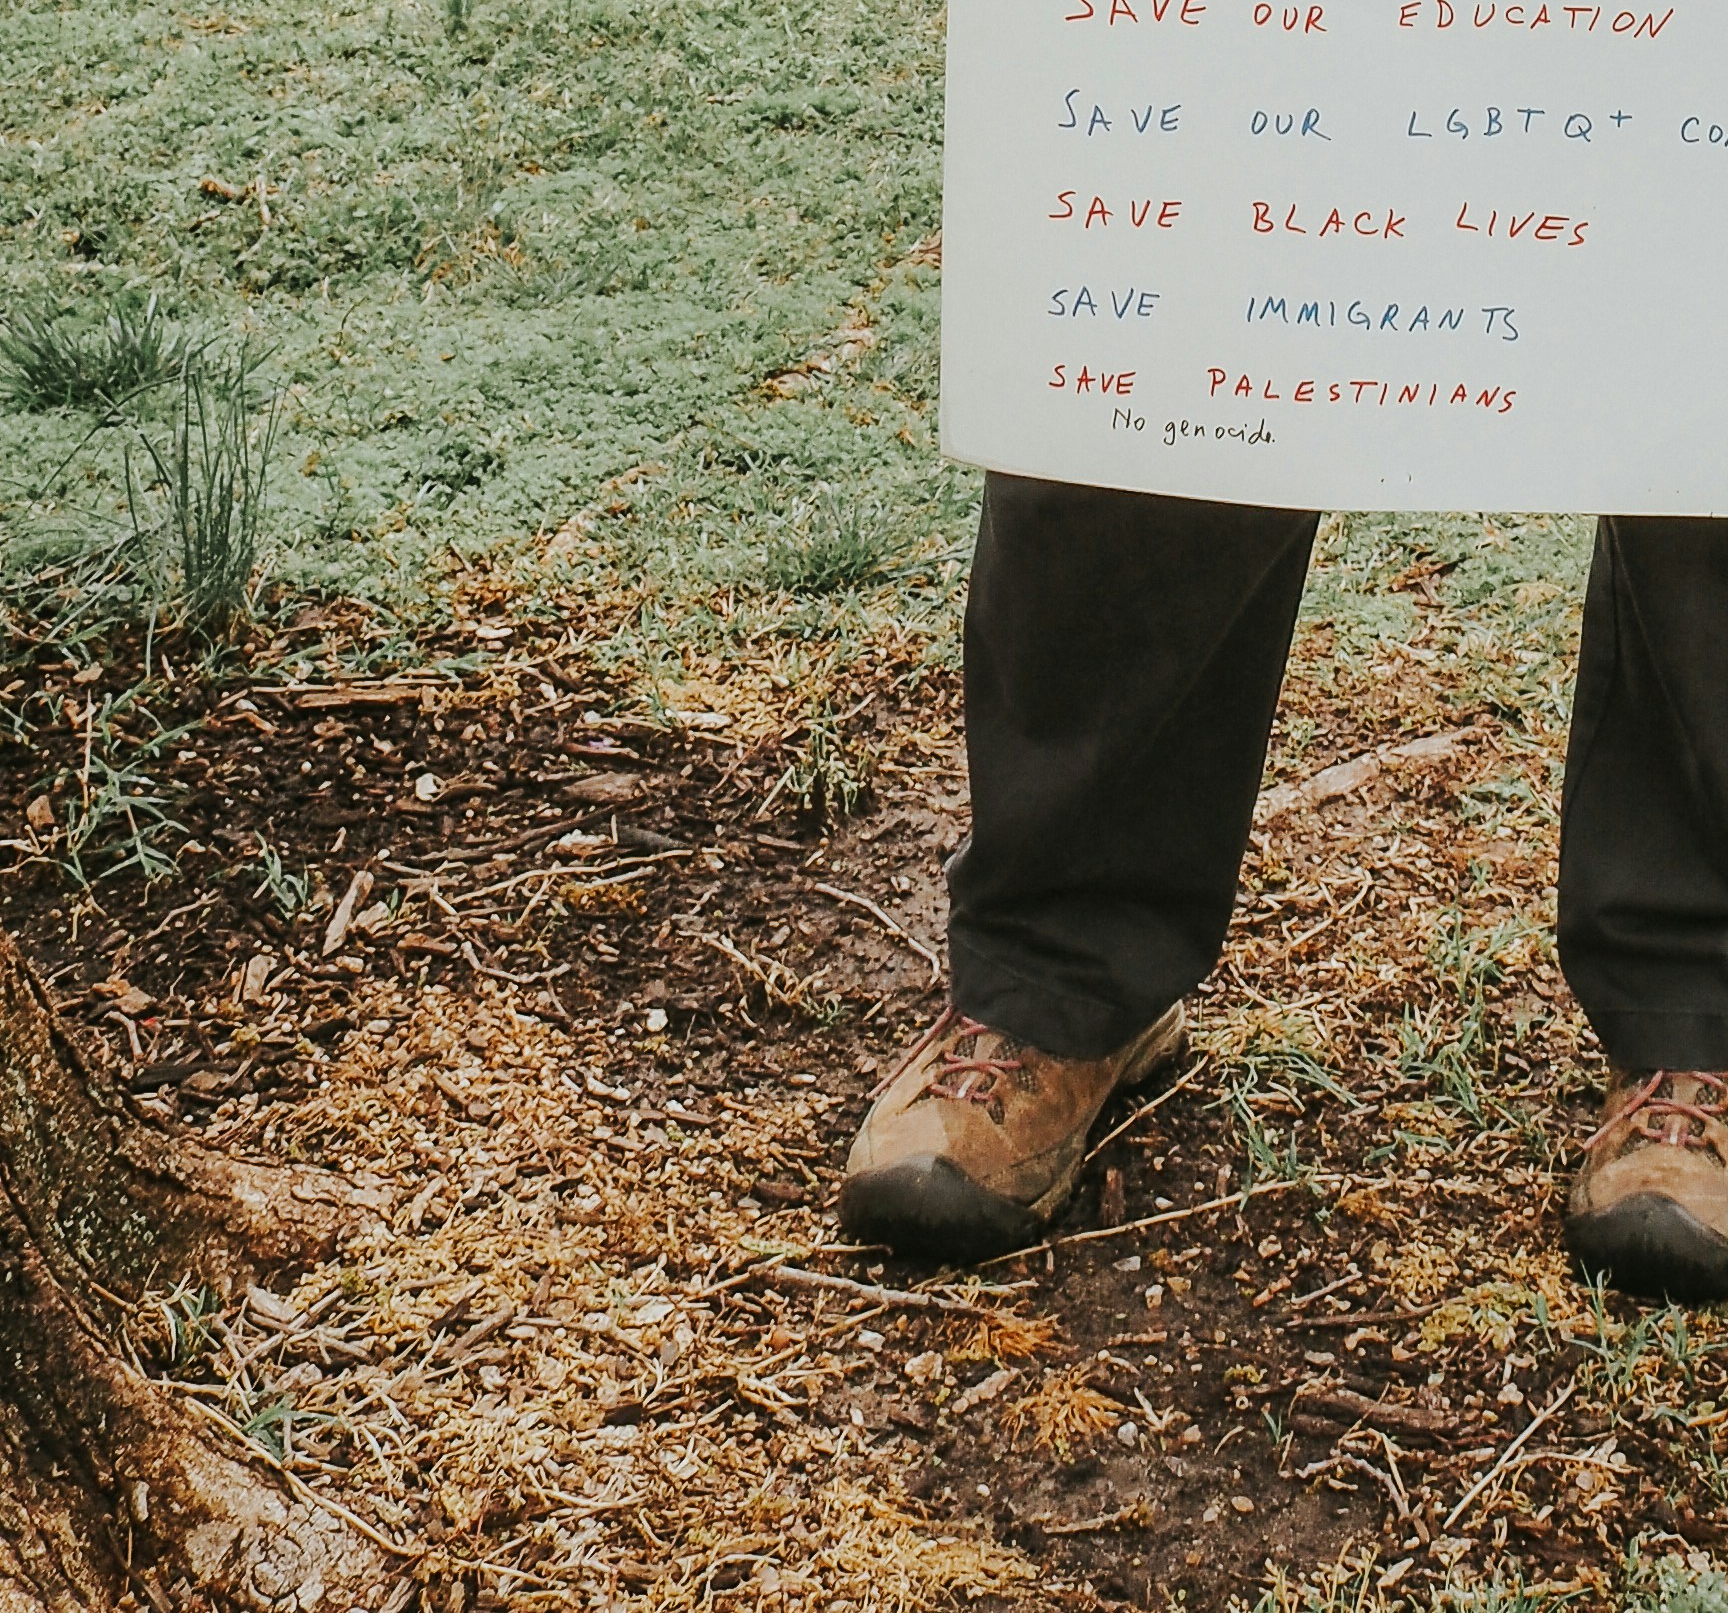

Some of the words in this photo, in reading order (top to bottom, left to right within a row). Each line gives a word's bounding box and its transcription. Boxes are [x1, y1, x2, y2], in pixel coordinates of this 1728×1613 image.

[1252, 1, 1328, 35] OUR
[1057, 88, 1182, 137] SAVE
[1250, 108, 1332, 142] OUR
[1407, 106, 1633, 143] LGBTQ+
[1048, 190, 1183, 230] SAVE
[1252, 200, 1406, 240] BLACK
[1455, 201, 1589, 246] LIVES
[1047, 285, 1161, 320] SAVE
[1246, 295, 1519, 342] IMMIGRANTS
[1048, 363, 1137, 397] SAVE
[1206, 366, 1517, 415] PALESTINIANS
[1112, 407, 1147, 432] No
